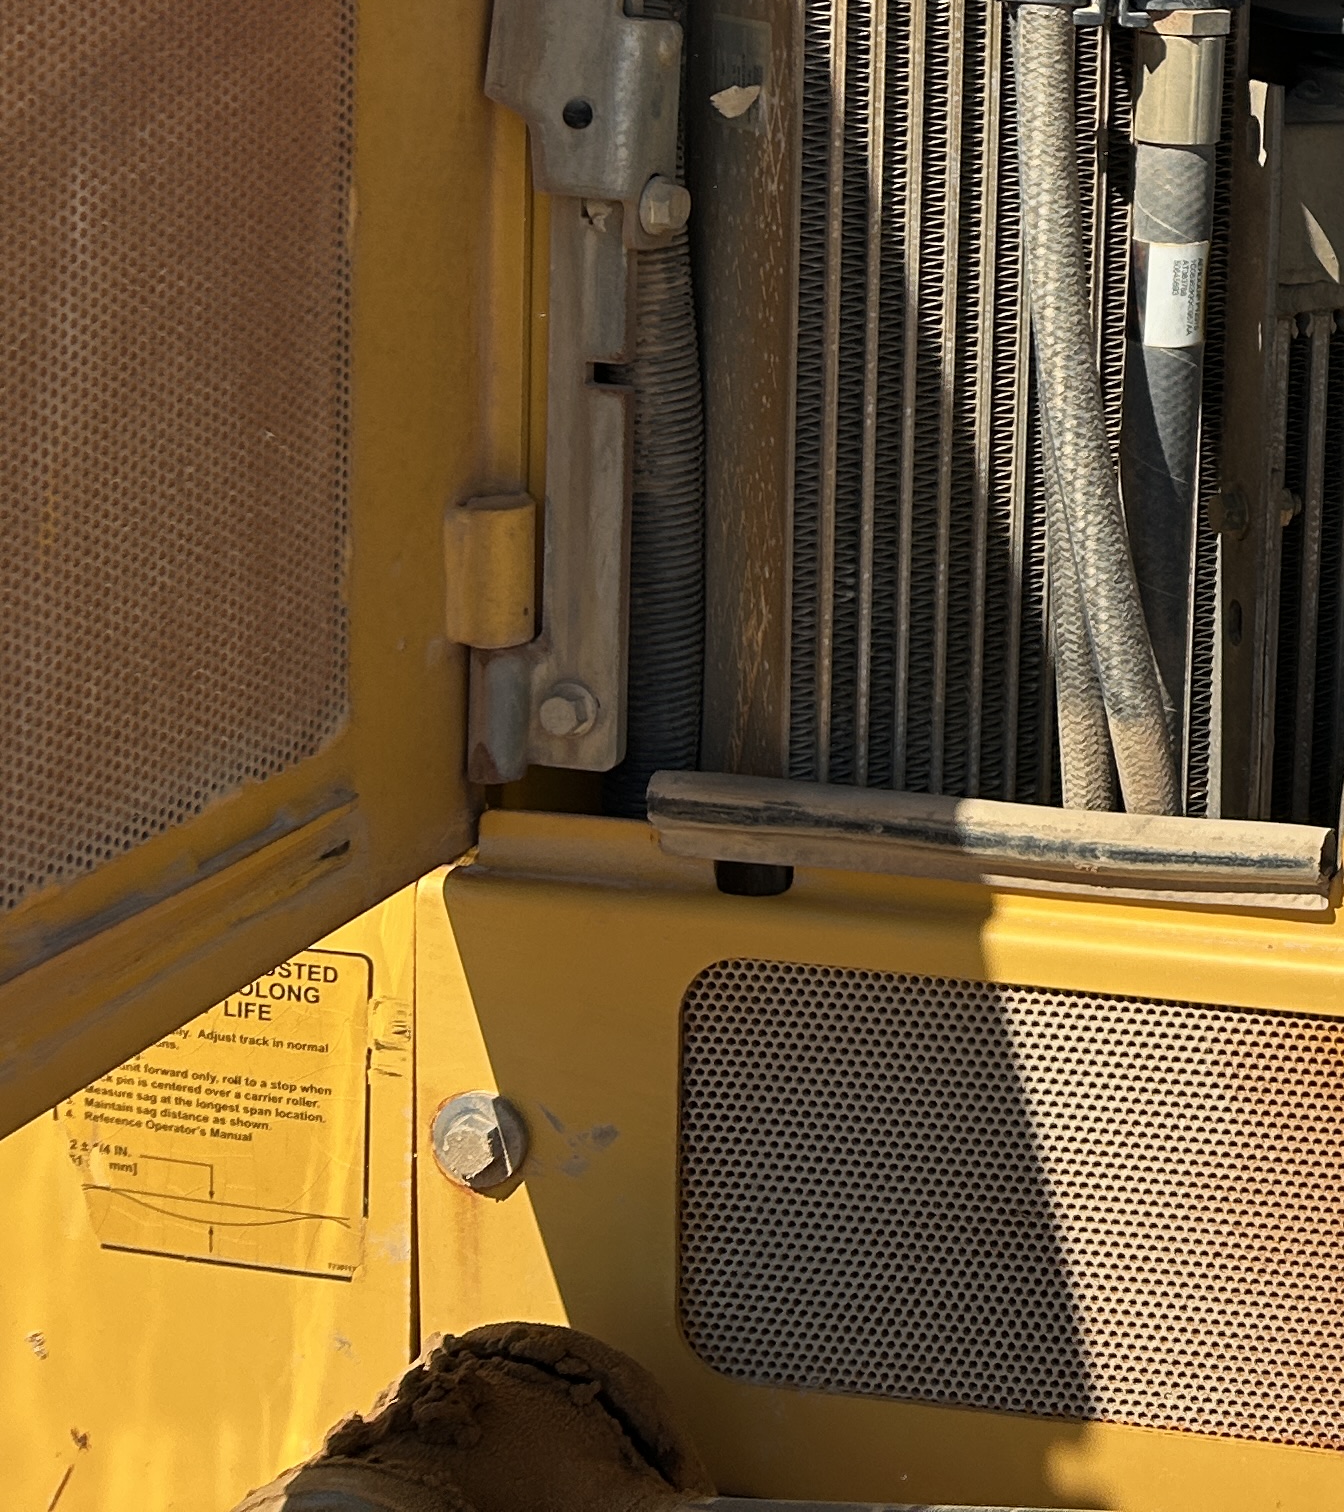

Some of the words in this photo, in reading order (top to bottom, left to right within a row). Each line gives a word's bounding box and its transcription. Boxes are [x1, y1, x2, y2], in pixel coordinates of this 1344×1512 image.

[223, 1000, 272, 1021] LIFE
[197, 1029, 237, 1043] Adjust
[239, 1034, 270, 1047] track
[272, 1037, 283, 1049] in
[286, 1040, 329, 1053] normal
[116, 1076, 135, 1086] pin
[137, 1077, 148, 1088] is
[150, 1080, 202, 1095] centered
[204, 1087, 231, 1098] over
[234, 1090, 242, 1099] a
[244, 1092, 283, 1104] carrier
[286, 1097, 321, 1109] roller.
[144, 1064, 189, 1079] forward
[191, 1071, 219, 1085] only,
[222, 1075, 242, 1086] roll
[244, 1077, 257, 1088] to
[260, 1080, 267, 1089] a
[270, 1080, 297, 1094] stop
[300, 1084, 332, 1096] when
[84, 1097, 133, 1112] Maintain
[136, 1106, 157, 1118] sag
[160, 1108, 209, 1123] distance
[212, 1115, 226, 1126] as
[229, 1117, 273, 1131] shown.
[136, 1092, 157, 1105] sag
[160, 1095, 172, 1105] at
[174, 1096, 192, 1108] the
[195, 1097, 240, 1113] longest
[243, 1105, 272, 1116] span
[275, 1108, 327, 1123] location.
[84, 1110, 142, 1128] Reference
[145, 1119, 207, 1136] Operator's
[210, 1128, 253, 1142] Manual
[69, 1138, 79, 1150] 2
[114, 1144, 133, 1157] IN.
